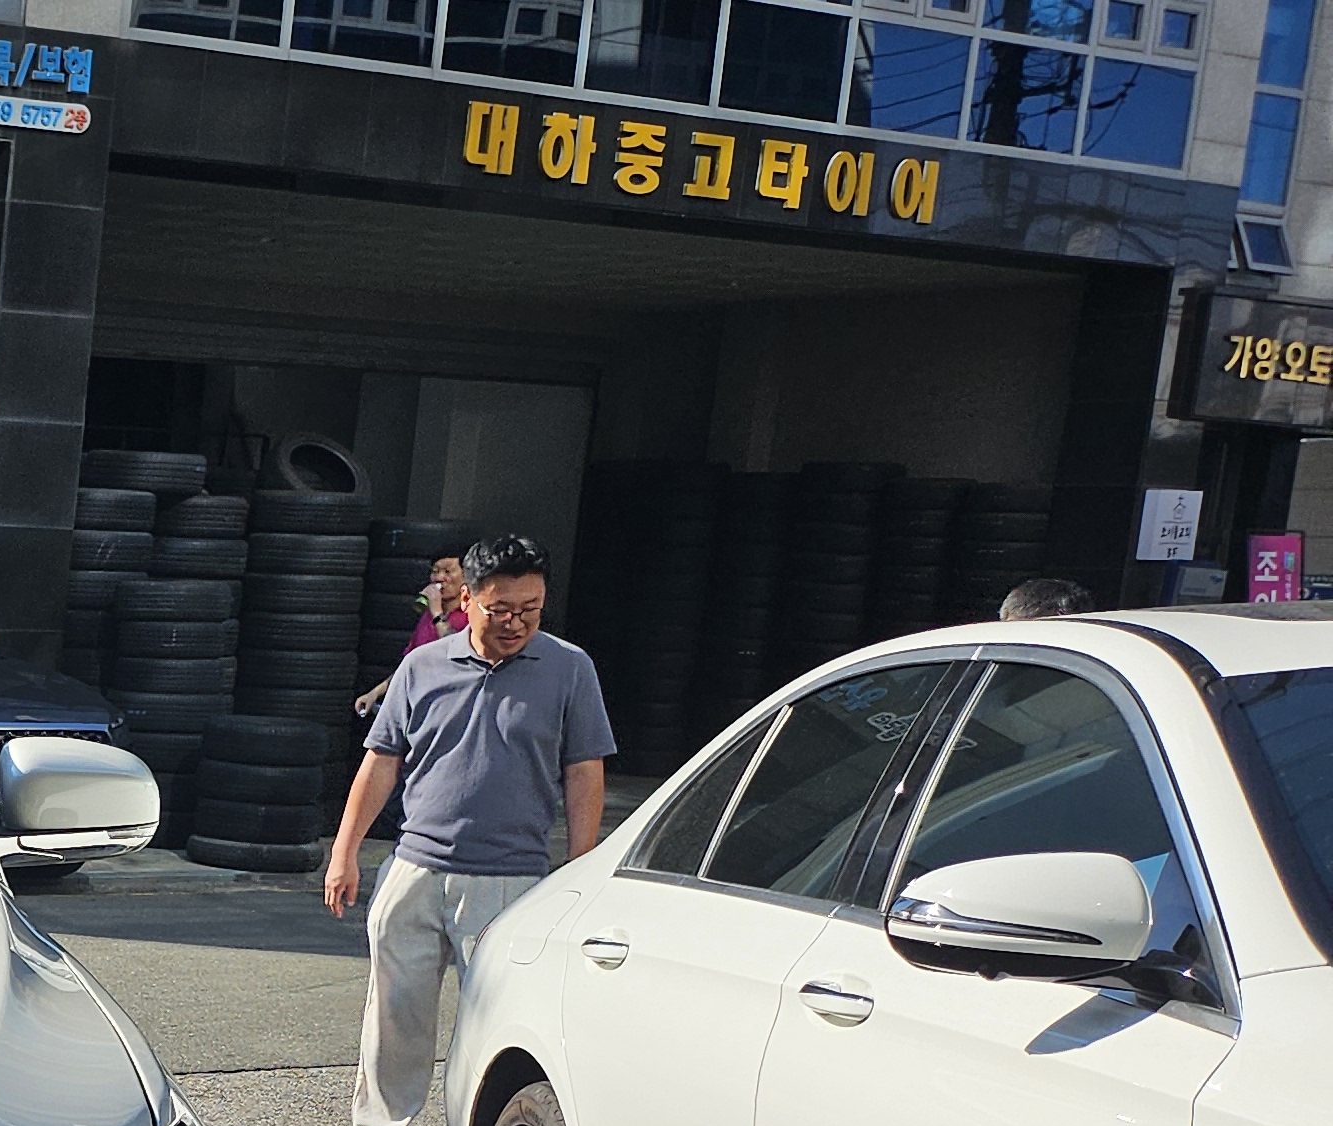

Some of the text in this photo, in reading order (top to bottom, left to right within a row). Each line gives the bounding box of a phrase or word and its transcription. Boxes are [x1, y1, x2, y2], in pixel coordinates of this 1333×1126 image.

[21, 104, 63, 127] 5757
[464, 101, 940, 224] 대하중고타이어
[1224, 335, 1333, 385] 가양오토
